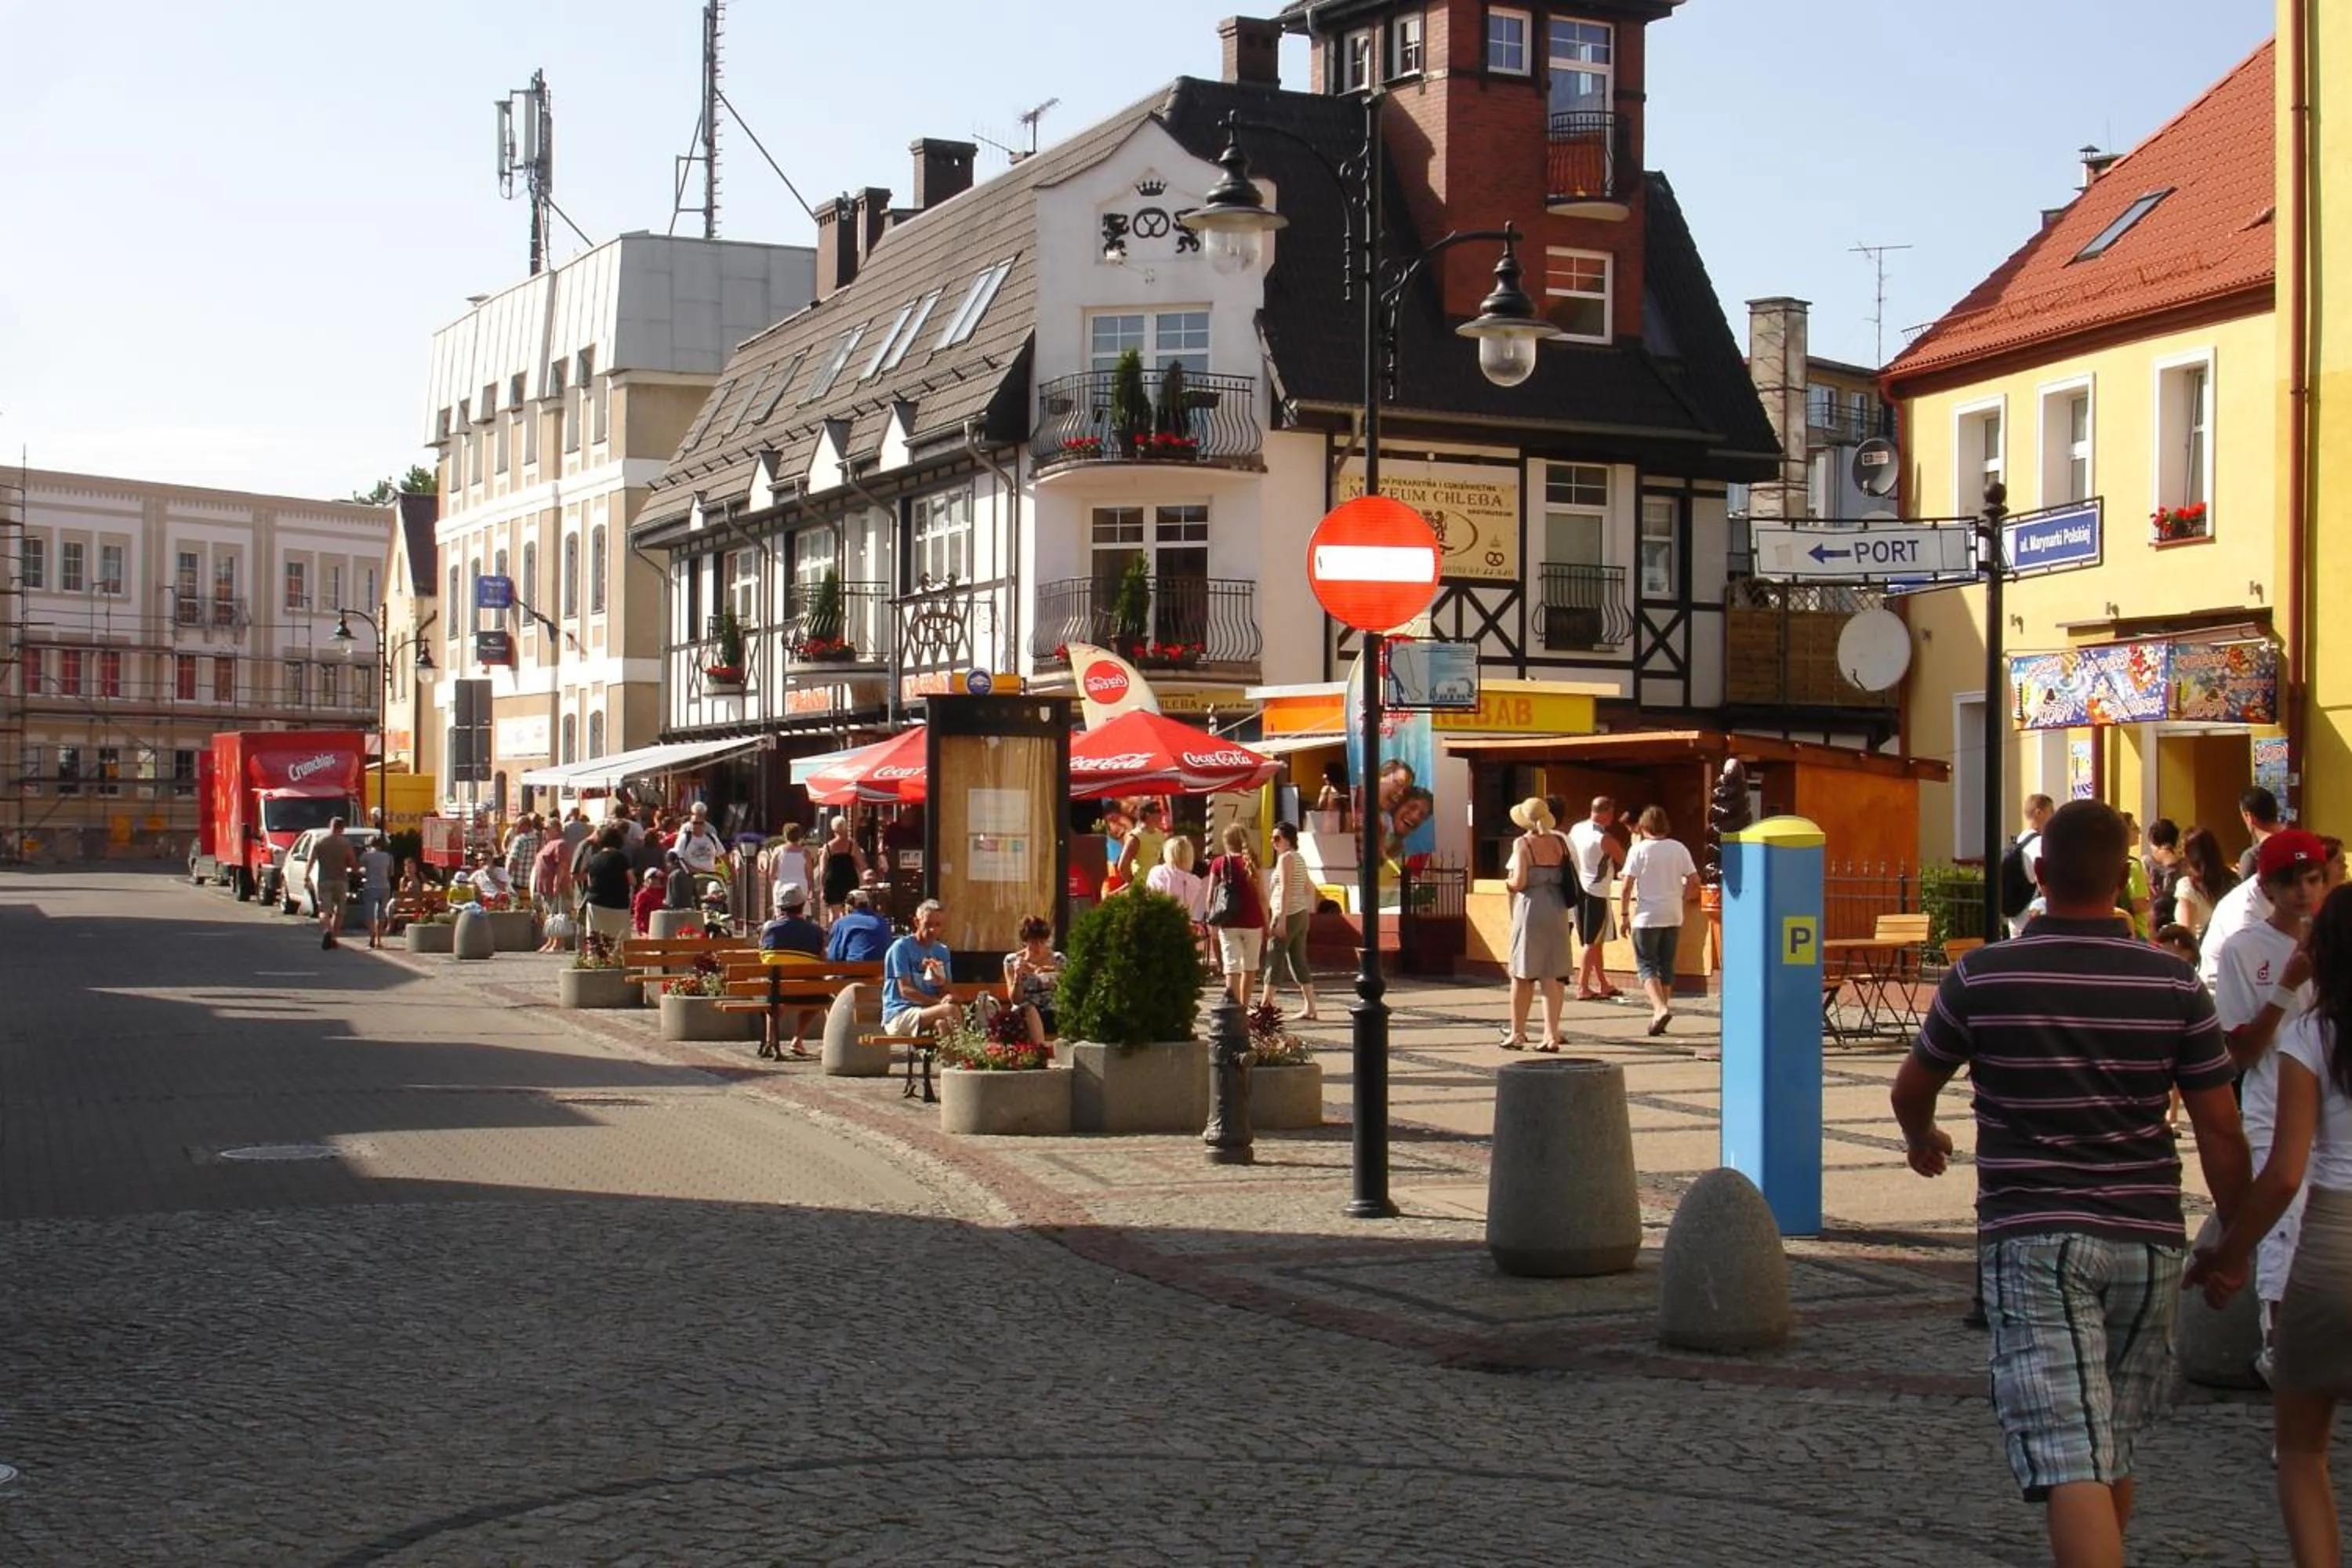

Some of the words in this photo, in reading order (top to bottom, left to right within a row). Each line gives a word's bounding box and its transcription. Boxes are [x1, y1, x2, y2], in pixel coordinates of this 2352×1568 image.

[1433, 491, 1503, 507] CHLEBA
[2019, 535, 2029, 553] ul.
[2030, 529, 2063, 553] Marynarki
[2063, 523, 2091, 546] Polskiej
[1854, 539, 1919, 564] PORT
[1183, 750, 1254, 768] Coca-Cola
[1790, 927, 1811, 954] P
